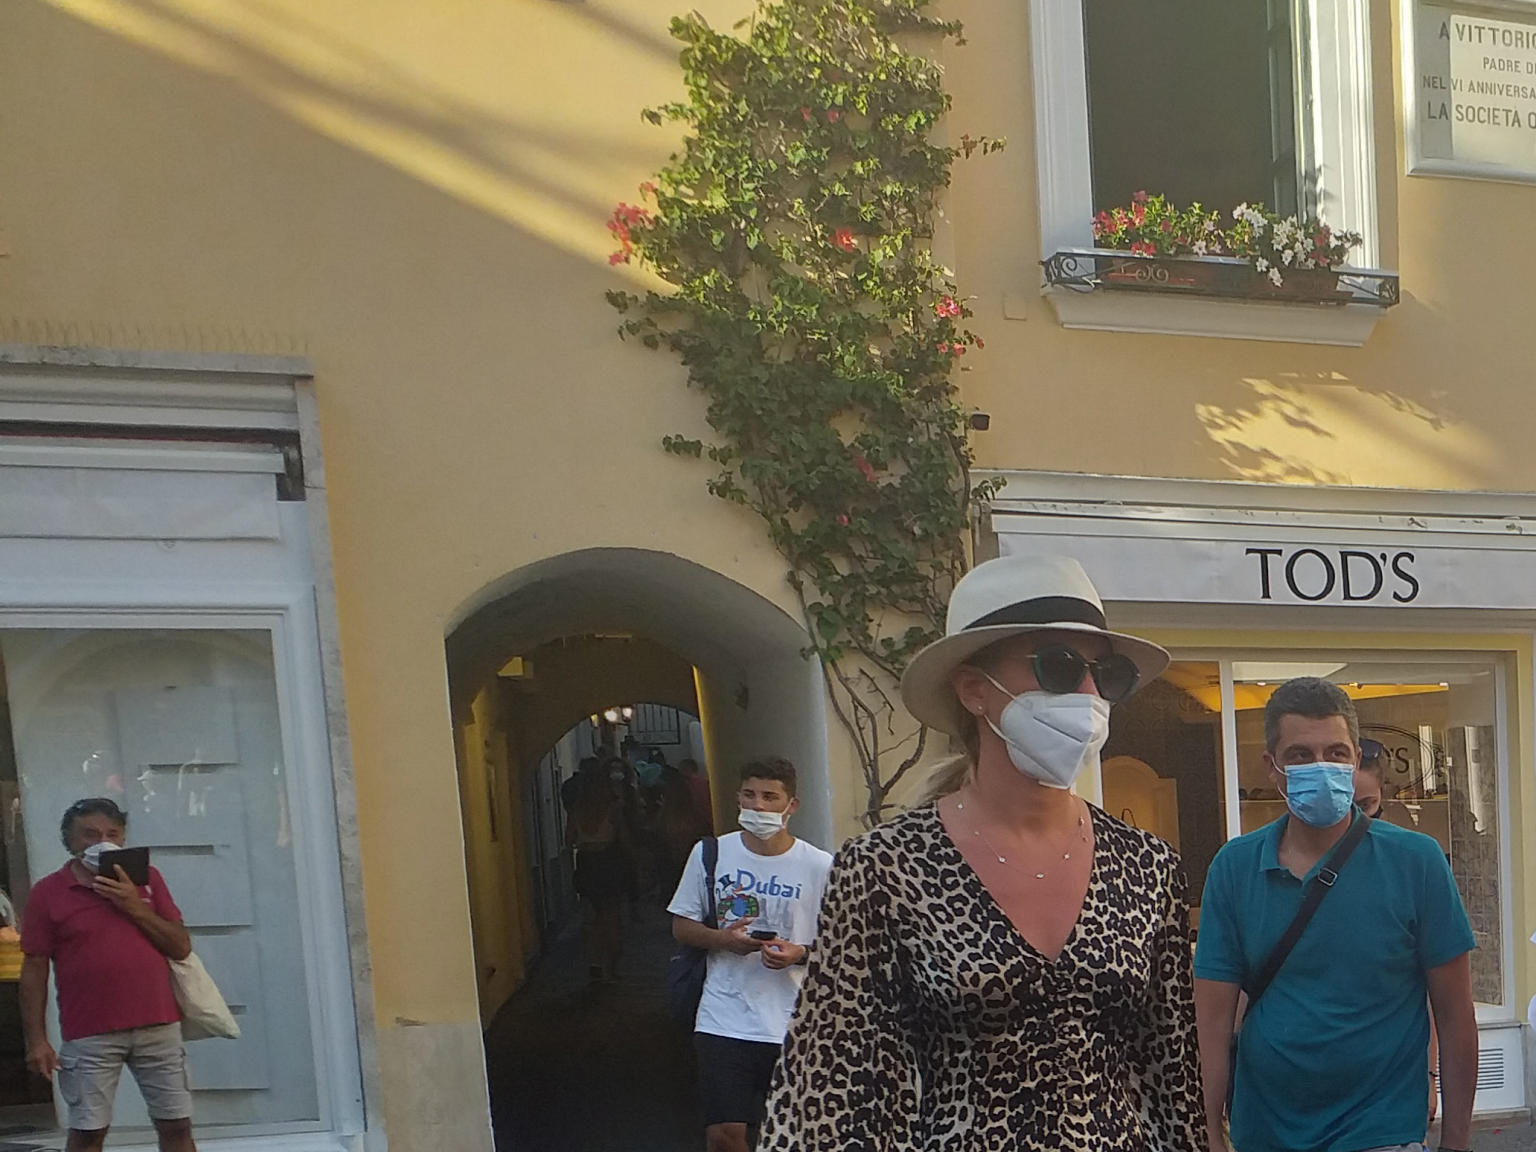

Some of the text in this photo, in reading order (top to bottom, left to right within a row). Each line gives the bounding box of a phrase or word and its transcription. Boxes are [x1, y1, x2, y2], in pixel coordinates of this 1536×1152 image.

[1438, 21, 1450, 40] A
[1482, 56, 1521, 74] PADRE
[1422, 75, 1447, 91] NEL
[1450, 78, 1463, 92] VI
[1427, 101, 1449, 121] LA
[1245, 547, 1420, 603] TOD'S
[735, 868, 803, 900] Dubai
